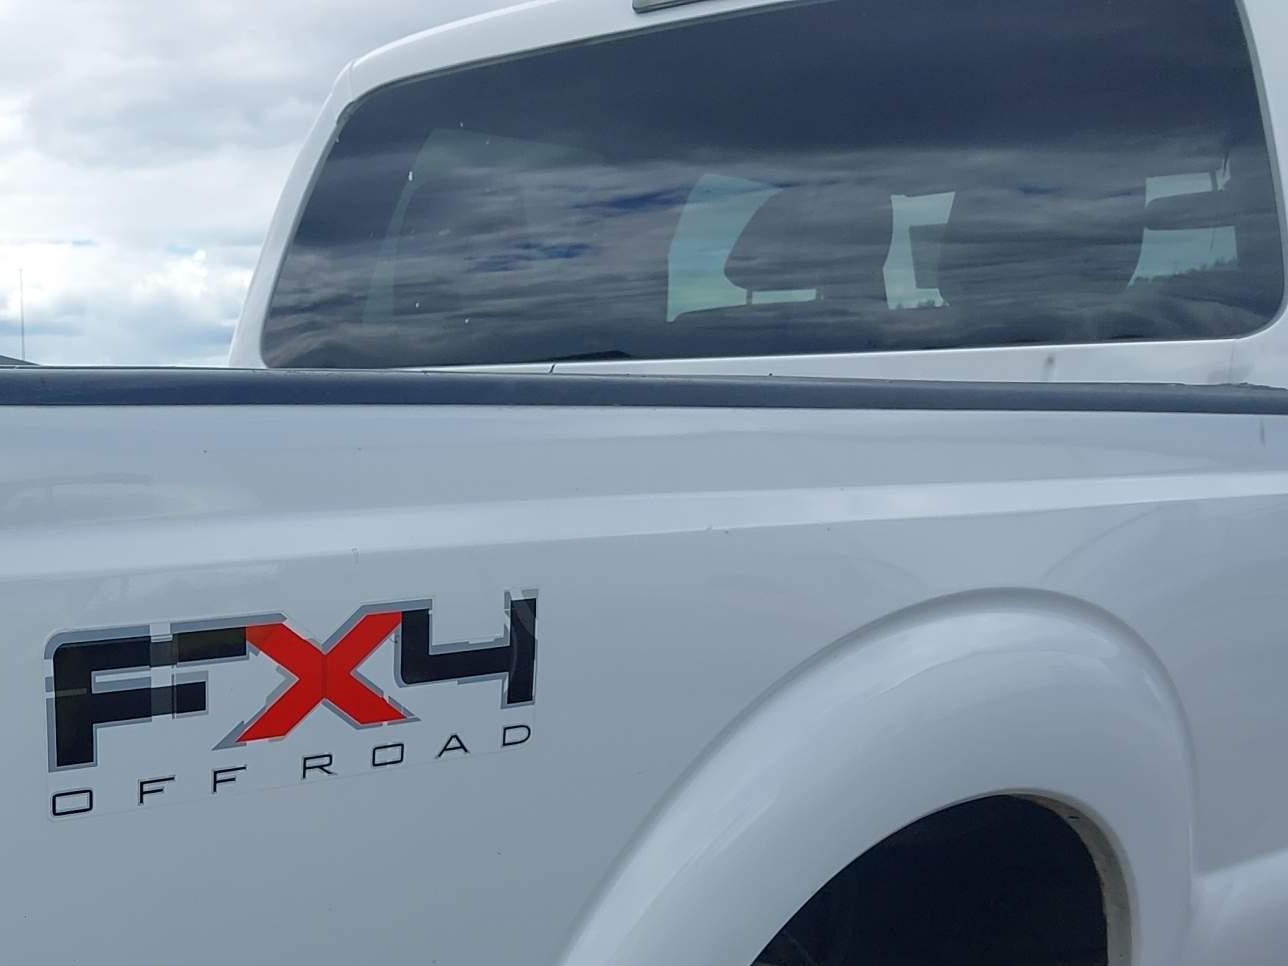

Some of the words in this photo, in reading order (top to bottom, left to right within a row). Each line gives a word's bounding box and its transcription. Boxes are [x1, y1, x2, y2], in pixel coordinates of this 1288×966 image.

[45, 588, 539, 773] FX4
[50, 763, 249, 817] OFF
[301, 723, 532, 779] ROAD
